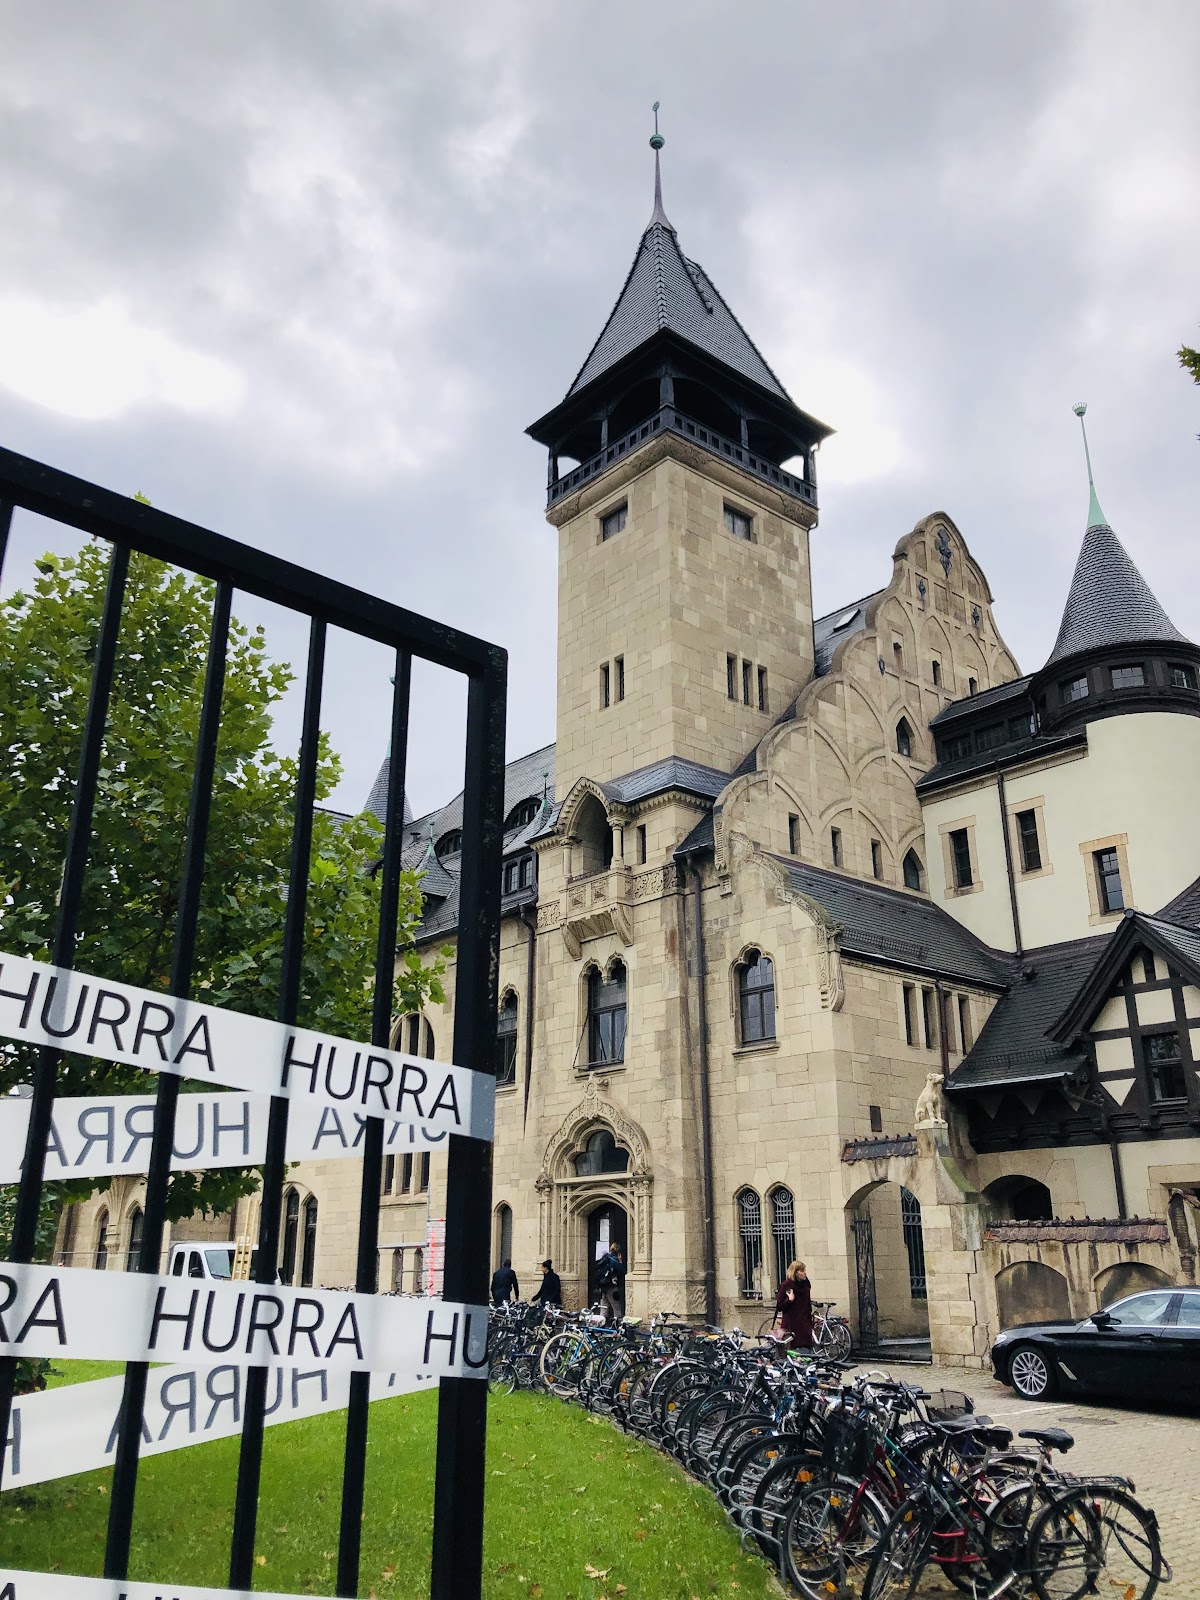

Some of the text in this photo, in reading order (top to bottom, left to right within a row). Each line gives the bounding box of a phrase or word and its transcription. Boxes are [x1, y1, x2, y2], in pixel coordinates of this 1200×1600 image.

[0, 963, 463, 1125] HURRA HURRA
[148, 1286, 364, 1360] HURRA
[422, 1309, 489, 1369] HU
